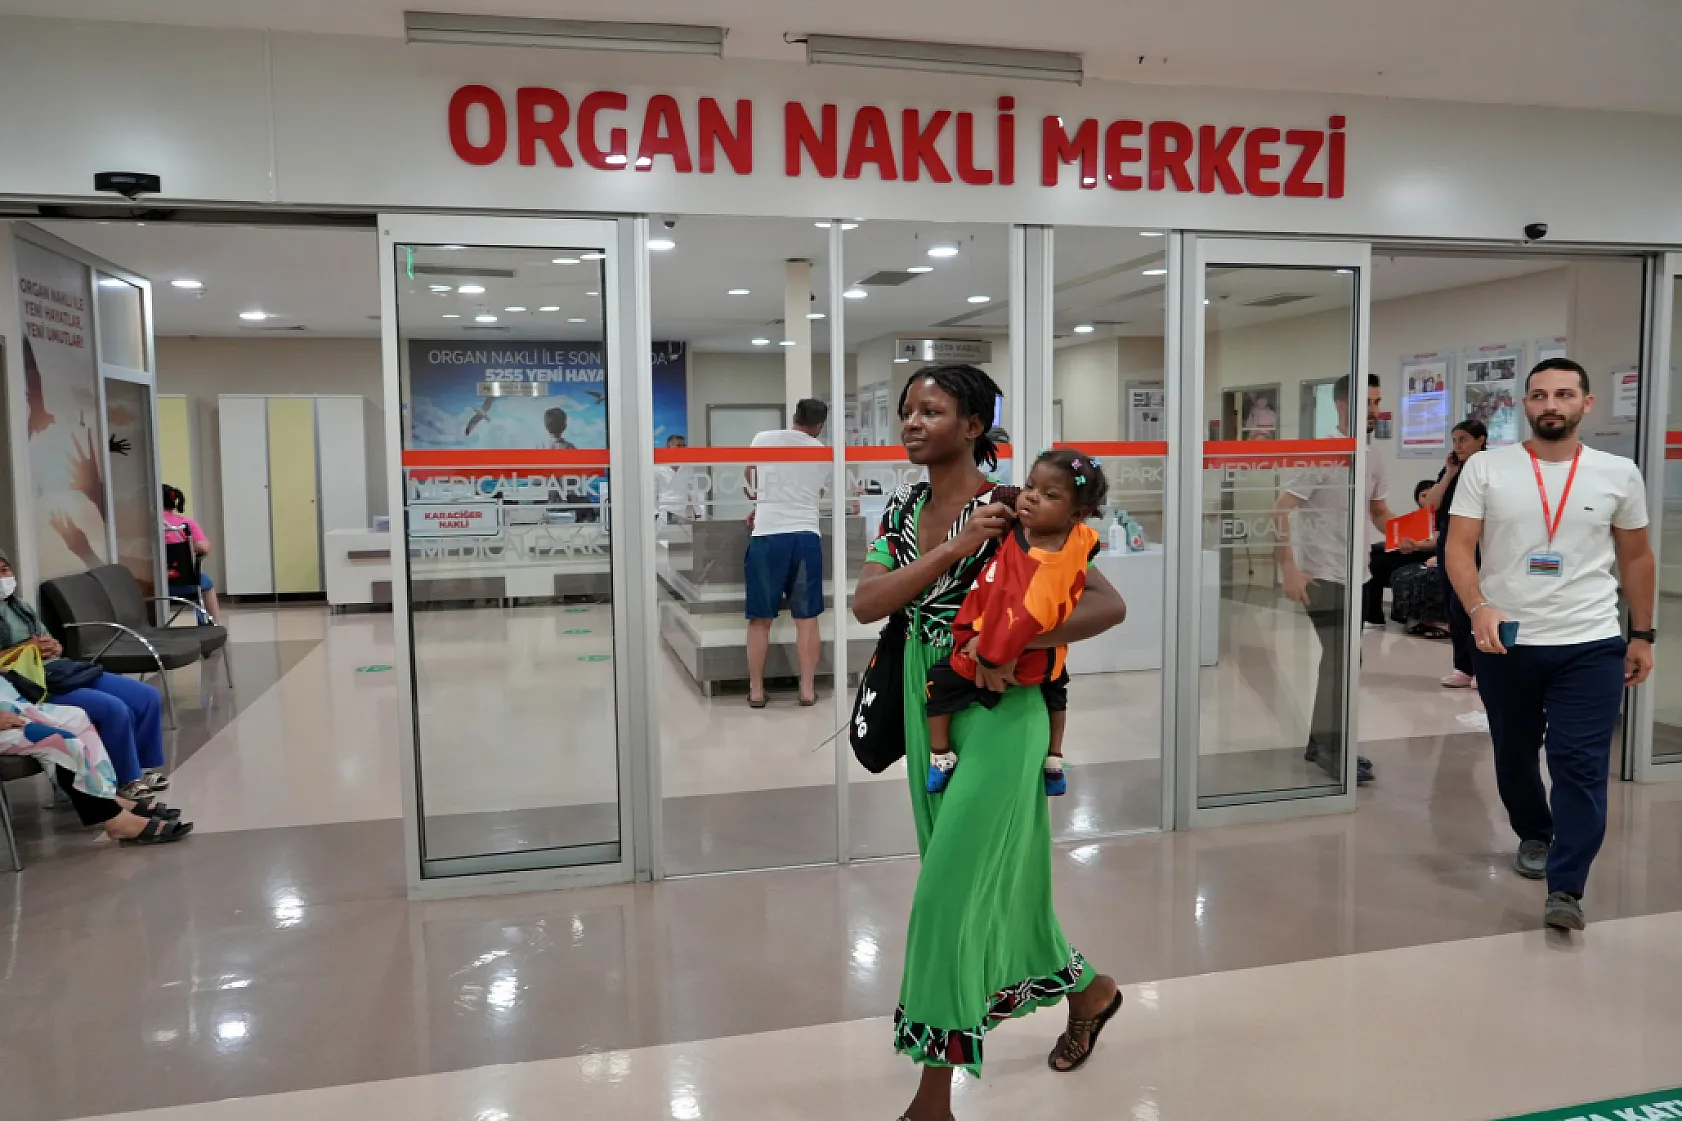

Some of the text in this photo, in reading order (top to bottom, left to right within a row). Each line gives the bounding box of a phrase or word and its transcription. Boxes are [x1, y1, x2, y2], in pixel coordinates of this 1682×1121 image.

[448, 85, 1346, 199] ORGAN NAKLİ MERKEZİ
[429, 349, 487, 364] ORGAN
[491, 349, 538, 365] NAKLİ
[569, 350, 600, 364] SON
[485, 366, 604, 382] 5255 YENİ HAYA
[438, 519, 470, 529] NAKLİ
